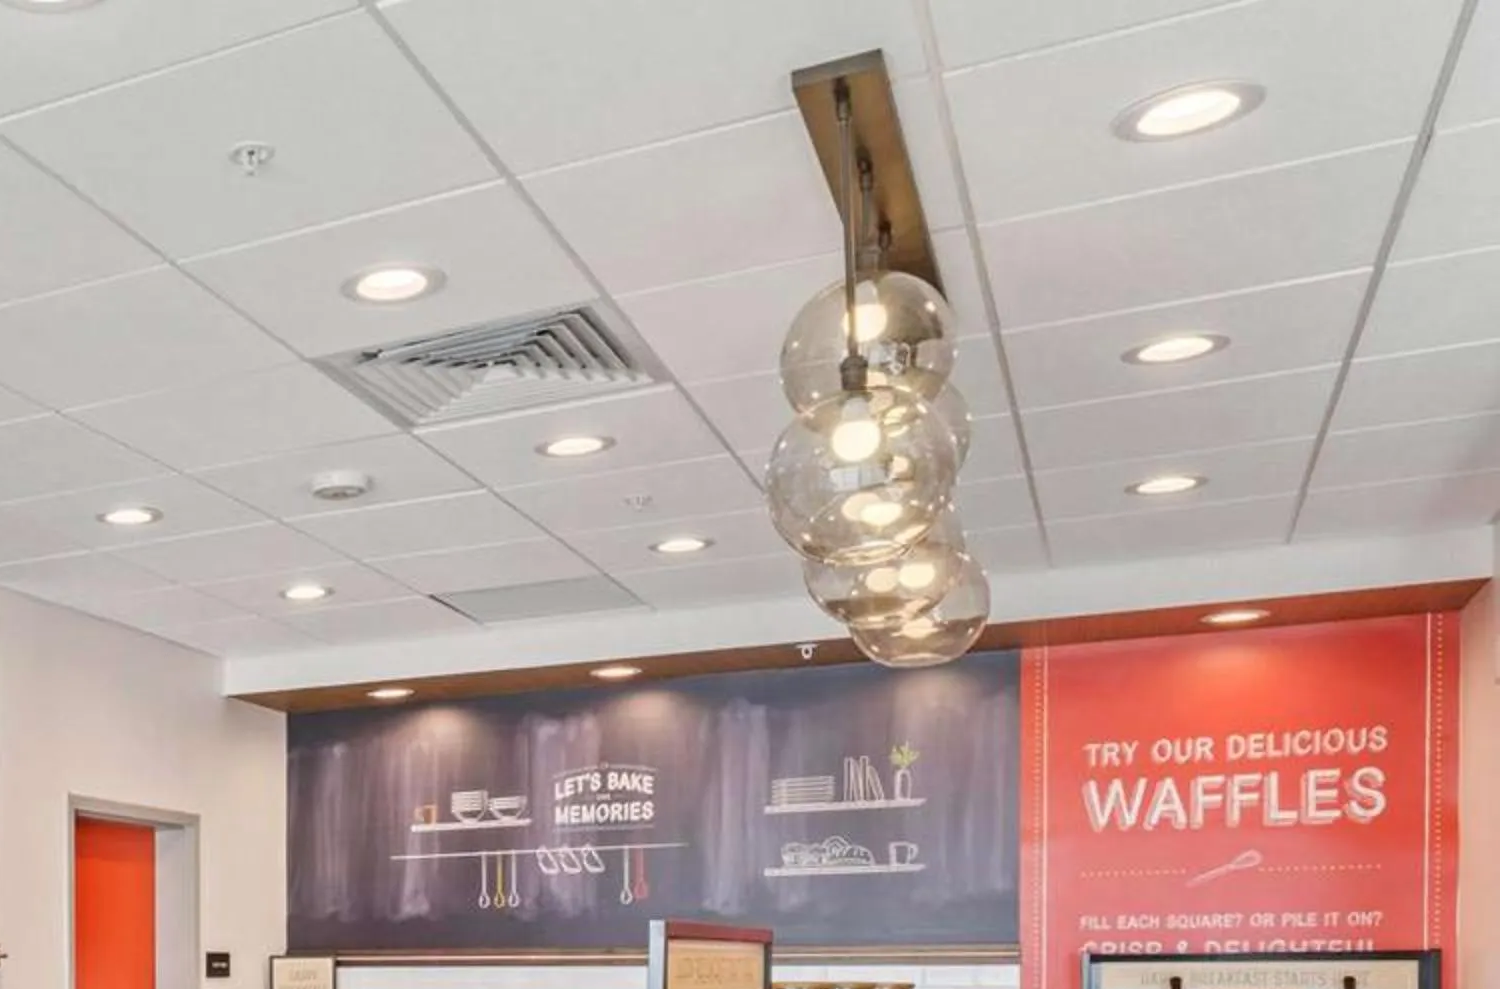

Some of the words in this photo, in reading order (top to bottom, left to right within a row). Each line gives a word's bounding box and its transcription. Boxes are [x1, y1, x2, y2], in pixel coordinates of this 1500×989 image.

[1084, 740, 1139, 768] TRY
[1151, 737, 1214, 763] OUR
[1227, 725, 1387, 760] DELICIOUS
[555, 771, 601, 801] LET'S
[607, 771, 654, 795] BAKE
[1082, 766, 1387, 832] WAFFLES
[555, 801, 654, 825] MEMORIES
[1079, 915, 1112, 930] FILL
[1116, 915, 1161, 930] EACH
[1166, 913, 1244, 929] SQUARE?
[1250, 913, 1275, 928] OR
[1281, 912, 1318, 927] PILE
[1323, 911, 1340, 928] IT
[1347, 911, 1384, 927] ON?
